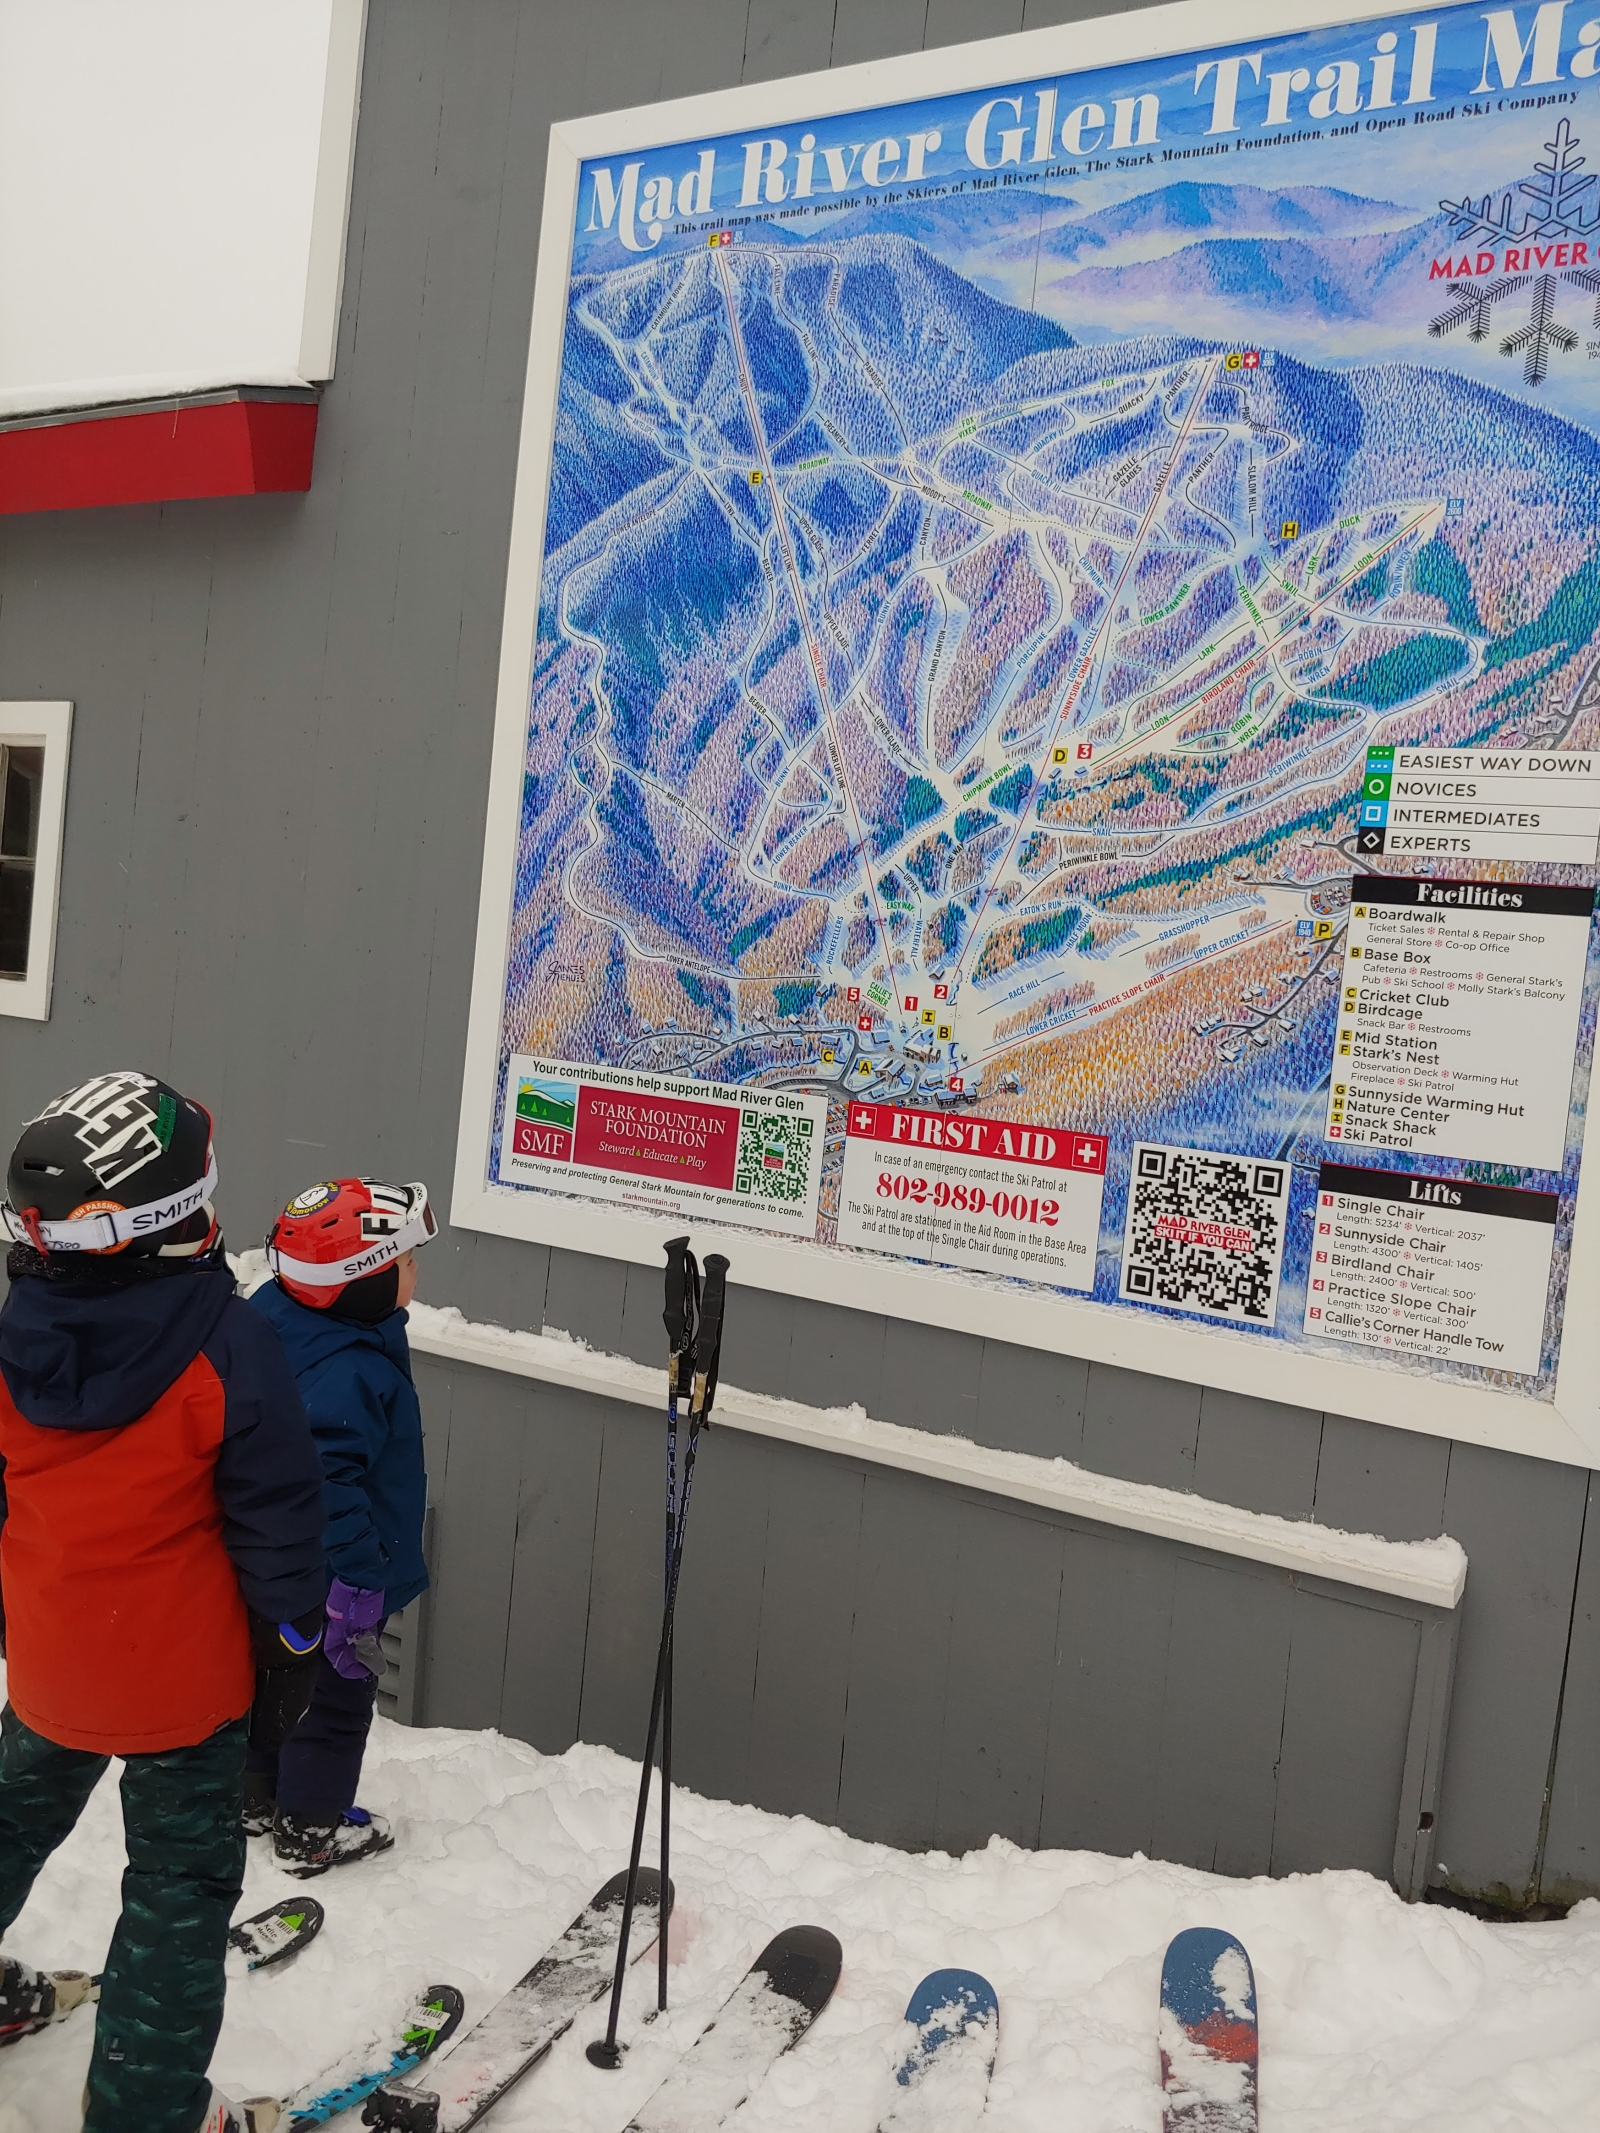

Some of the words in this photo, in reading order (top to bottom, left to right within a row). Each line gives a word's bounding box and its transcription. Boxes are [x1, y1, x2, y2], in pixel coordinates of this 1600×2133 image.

[585, 150, 716, 252] Mad
[736, 133, 941, 208] River
[965, 88, 1160, 170] Glen
[1194, 22, 1438, 135] Trail
[673, 223, 697, 234] This
[701, 219, 723, 230] trail
[728, 216, 751, 227] map
[755, 212, 775, 223] was
[780, 206, 810, 218] made
[814, 199, 861, 216] possible
[866, 195, 879, 207] by
[884, 191, 902, 202] the
[906, 185, 947, 200] Skiers
[952, 181, 967, 194] of
[971, 176, 997, 191] Mad
[1003, 171, 1040, 186] River
[1045, 165, 1079, 179] Glen,
[1085, 161, 1111, 173] The
[1116, 152, 1154, 168] Stark
[1161, 142, 1229, 162] Mountain
[1236, 130, 1324, 151] Foundation,
[1331, 121, 1359, 137] and
[1366, 115, 1406, 132] Open
[1414, 107, 1455, 125] Road
[1462, 102, 1491, 118] Ski
[1497, 90, 1579, 112] Company
[1428, 252, 1495, 280] MAD
[1503, 242, 1588, 273] RIVER
[1101, 378, 1115, 388] FOX
[1165, 370, 1190, 401] PANTHER
[1117, 394, 1144, 414] QUACKY
[958, 425, 977, 439] VIXEN
[1153, 461, 1172, 493] GAZELLE
[921, 485, 947, 503] MOODY'S
[962, 491, 993, 512] BROADWAY
[1339, 515, 1361, 529] DUCK
[861, 529, 880, 553] FERRET
[1354, 553, 1374, 572] LOON
[1237, 585, 1265, 627] PERIWINKLE
[1017, 632, 1047, 668] PORCUPINE
[1197, 644, 1216, 660] LARK
[1060, 679, 1082, 720] SUNNYSIDE
[1078, 656, 1092, 679] CHAIR
[1201, 675, 1235, 705] BIRDLAND
[1235, 660, 1256, 680] CHAIR
[1436, 678, 1461, 694] SNAIL
[749, 695, 766, 715] BEAVER
[1400, 755, 1475, 769] EASIEST
[1480, 757, 1522, 770] WAY
[1528, 758, 1591, 773] DOWN
[775, 766, 790, 788] BUNNY
[1397, 782, 1476, 797] NOVICES
[1393, 810, 1540, 827] INTERMEDIATES
[1390, 837, 1471, 851] EXPERTS
[1416, 883, 1523, 908] Facilities
[1356, 908, 1365, 917] A
[1369, 908, 1446, 923] Boardwalk
[1158, 915, 1211, 942] GRASSHOPPER
[1369, 923, 1396, 933] Ticket
[1400, 925, 1425, 935] Sales
[1438, 928, 1470, 938] Rental
[1483, 931, 1515, 942] Repair
[1519, 933, 1545, 944] Shop
[1352, 949, 1360, 957] B
[1365, 950, 1398, 961] Base
[1404, 952, 1431, 964] Box
[1008, 986, 1025, 1000] RACE
[1025, 979, 1041, 994] HILL
[1347, 989, 1355, 997] C
[1360, 990, 1411, 1003] Cricket
[1416, 994, 1449, 1007] Club
[1345, 1003, 1354, 1011] D
[1358, 1004, 1423, 1020] Birdcage
[1342, 1031, 1349, 1040] E
[1355, 1032, 1380, 1043] Mid
[1385, 1035, 1437, 1050] Station
[1341, 1045, 1348, 1054] F
[1353, 1046, 1401, 1060] Stark's
[1407, 1052, 1440, 1065] Nest
[1353, 1061, 1411, 1074] Observation
[1414, 1067, 1438, 1077] Deck
[1453, 1072, 1497, 1085] Warming
[1501, 1076, 1519, 1086] Hut
[533, 1061, 558, 1074] Your
[560, 1067, 633, 1086] contributions
[637, 1076, 661, 1092] help
[664, 1081, 709, 1097] support
[713, 1087, 737, 1101] Mad
[740, 1091, 772, 1106] River
[775, 1096, 804, 1111] Glen
[1335, 1100, 1342, 1108] H
[1347, 1100, 1396, 1116] Nature
[1401, 1107, 1450, 1122] Center
[1336, 1086, 1345, 1094] G
[1349, 1086, 1422, 1106] Sunnyside
[1427, 1095, 1493, 1115] Warming
[1498, 1104, 1525, 1117] Hut
[590, 1100, 636, 1121] STARK
[640, 1108, 726, 1135] MOUNTAIN
[1333, 1114, 1341, 1122] I
[1345, 1115, 1387, 1129] Snack
[1393, 1121, 1436, 1136] Shack
[520, 1129, 564, 1155] SMF
[605, 1119, 707, 1148] FOUNDATION
[890, 1113, 988, 1151] FIRST
[993, 1129, 1056, 1161] AID
[1344, 1129, 1365, 1141] Ski
[1370, 1132, 1413, 1147] Patrol
[875, 1151, 881, 1162] In
[884, 1155, 901, 1165] case
[904, 1156, 911, 1167] of
[913, 1160, 922, 1169] an
[925, 1161, 967, 1178] emergency
[969, 1167, 998, 1180] contact
[1002, 1172, 1014, 1183] the
[1017, 1174, 1029, 1186] Ski
[1032, 1178, 1056, 1190] Patrol
[1058, 1182, 1067, 1192] at
[622, 1192, 681, 1210] starkmountain.org
[876, 1172, 1060, 1226] 802-989-0012
[1409, 1180, 1462, 1205] Lifts
[132, 1191, 203, 1230] SMITH
[1325, 1197, 1331, 1205] 1
[1337, 1198, 1381, 1213] Single
[1387, 1205, 1425, 1220] Chair
[1158, 1215, 1188, 1228] MAD
[1191, 1221, 1221, 1234] RIVER
[1224, 1227, 1250, 1239] GLEN
[1321, 1225, 1329, 1233] 2
[1334, 1226, 1405, 1246] Sunnyside
[1410, 1238, 1446, 1253] Chair
[1337, 1213, 1372, 1225] Length:
[1375, 1218, 1402, 1229] 5234'
[1416, 1224, 1454, 1237] Vertical:
[1457, 1231, 1485, 1242] 2037'
[344, 1241, 399, 1276] SMITH
[1318, 1252, 1325, 1261] 3
[1332, 1254, 1391, 1274] Birdland
[1397, 1265, 1435, 1281] Chair
[1314, 1281, 1323, 1290] 4
[1328, 1283, 1385, 1302] Practice
[1391, 1293, 1432, 1310] Slope
[1438, 1302, 1476, 1317] Chair
[1311, 1308, 1319, 1318] 5
[1325, 1311, 1371, 1329] Callie's
[1374, 1320, 1419, 1337] Corner
[1424, 1328, 1472, 1346] Handle
[1476, 1337, 1504, 1352] Tow
